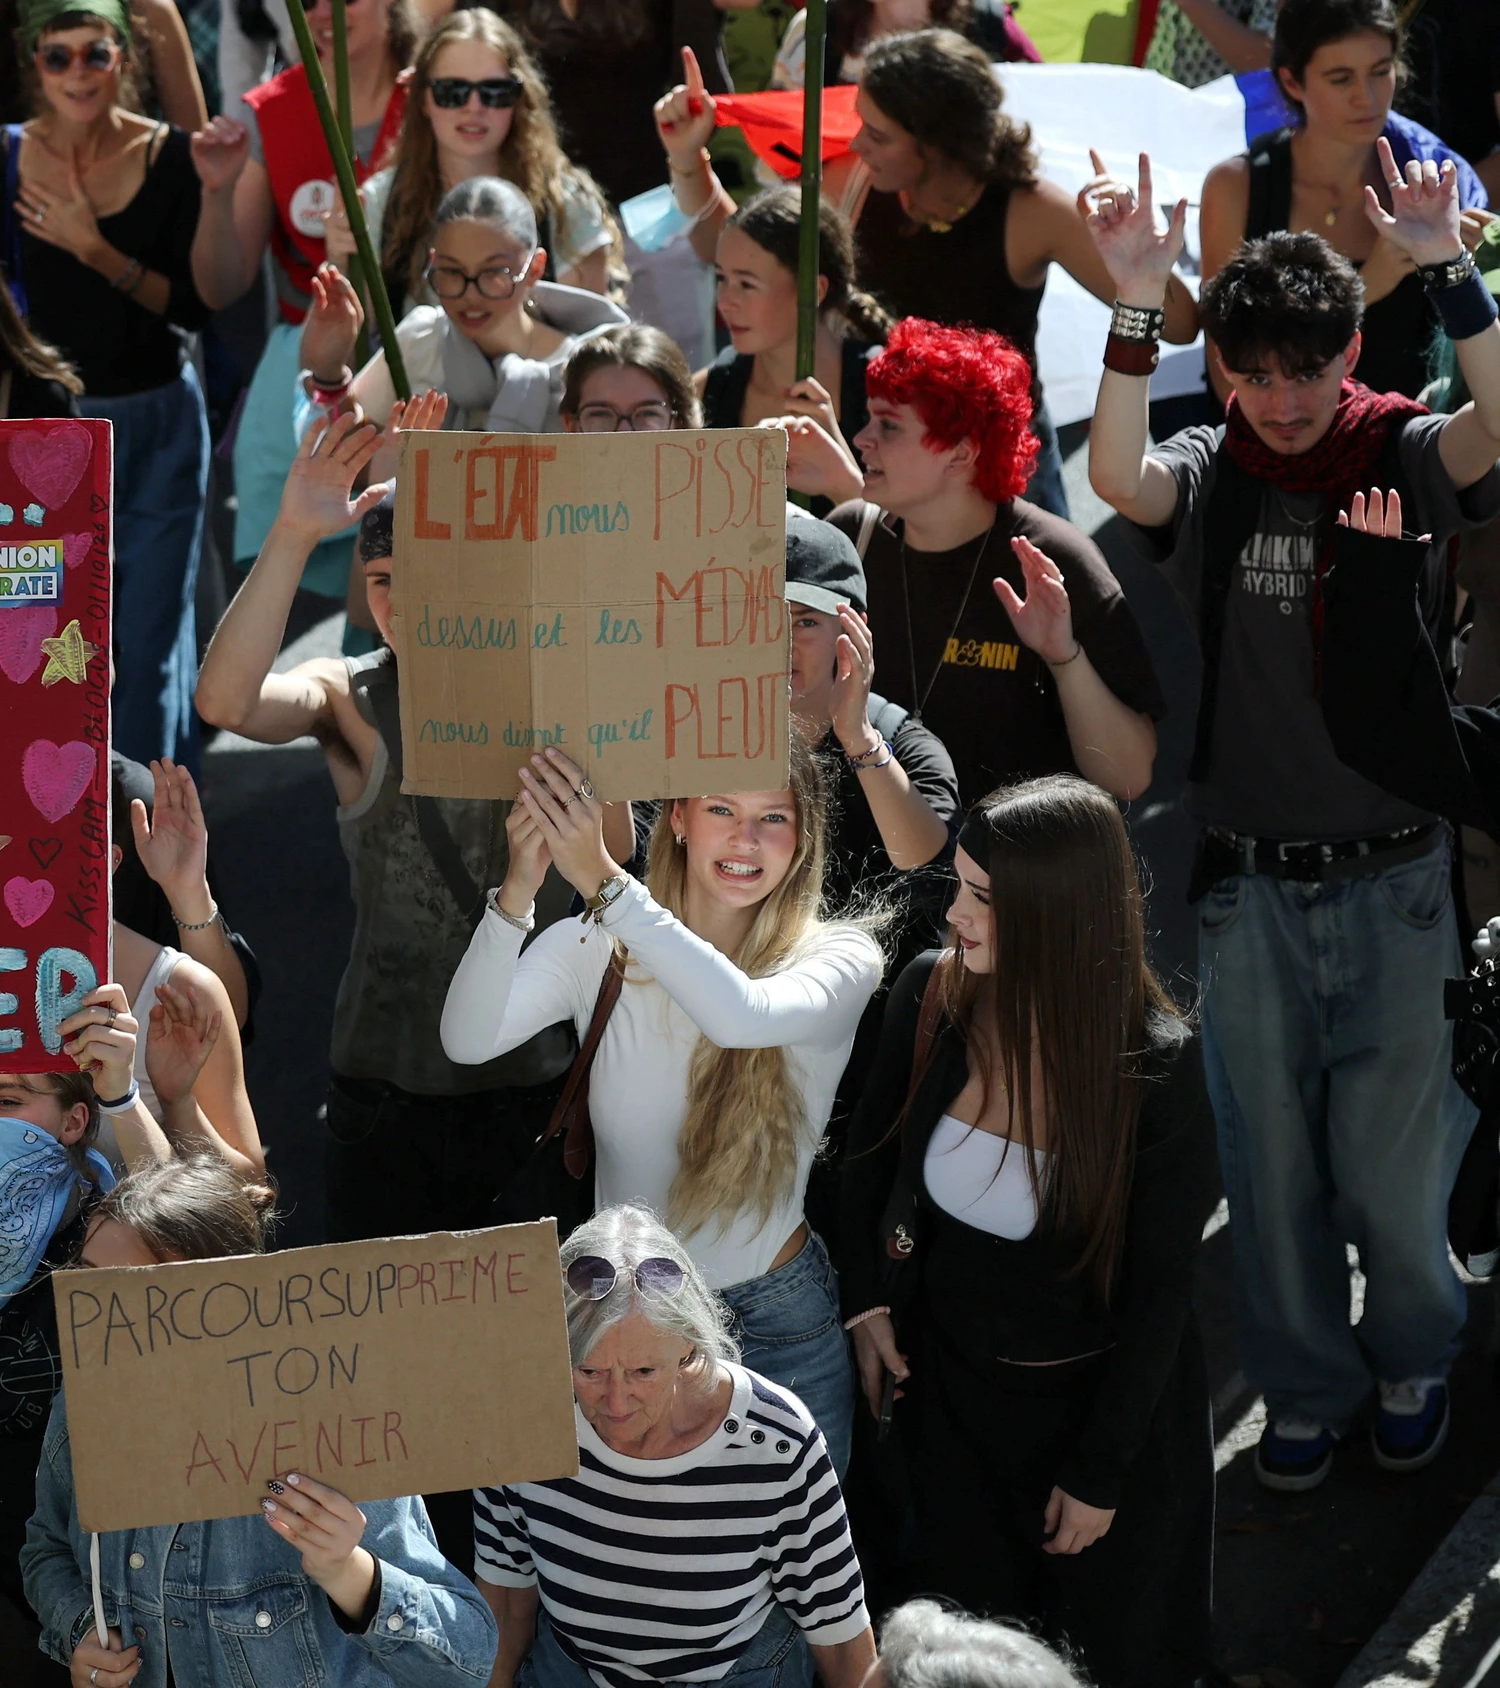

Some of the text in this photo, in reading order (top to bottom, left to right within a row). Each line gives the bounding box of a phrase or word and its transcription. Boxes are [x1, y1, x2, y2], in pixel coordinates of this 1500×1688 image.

[414, 435, 557, 542] L'ÉTAT
[544, 499, 631, 538] nous
[417, 604, 518, 650] dessus
[531, 613, 567, 650] et
[595, 608, 643, 645] les
[420, 719, 489, 745] nous
[588, 708, 654, 759] qu'il
[664, 672, 788, 760] PLEUT
[227, 1343, 360, 1407] TON
[185, 1411, 409, 1487] AVENIR
